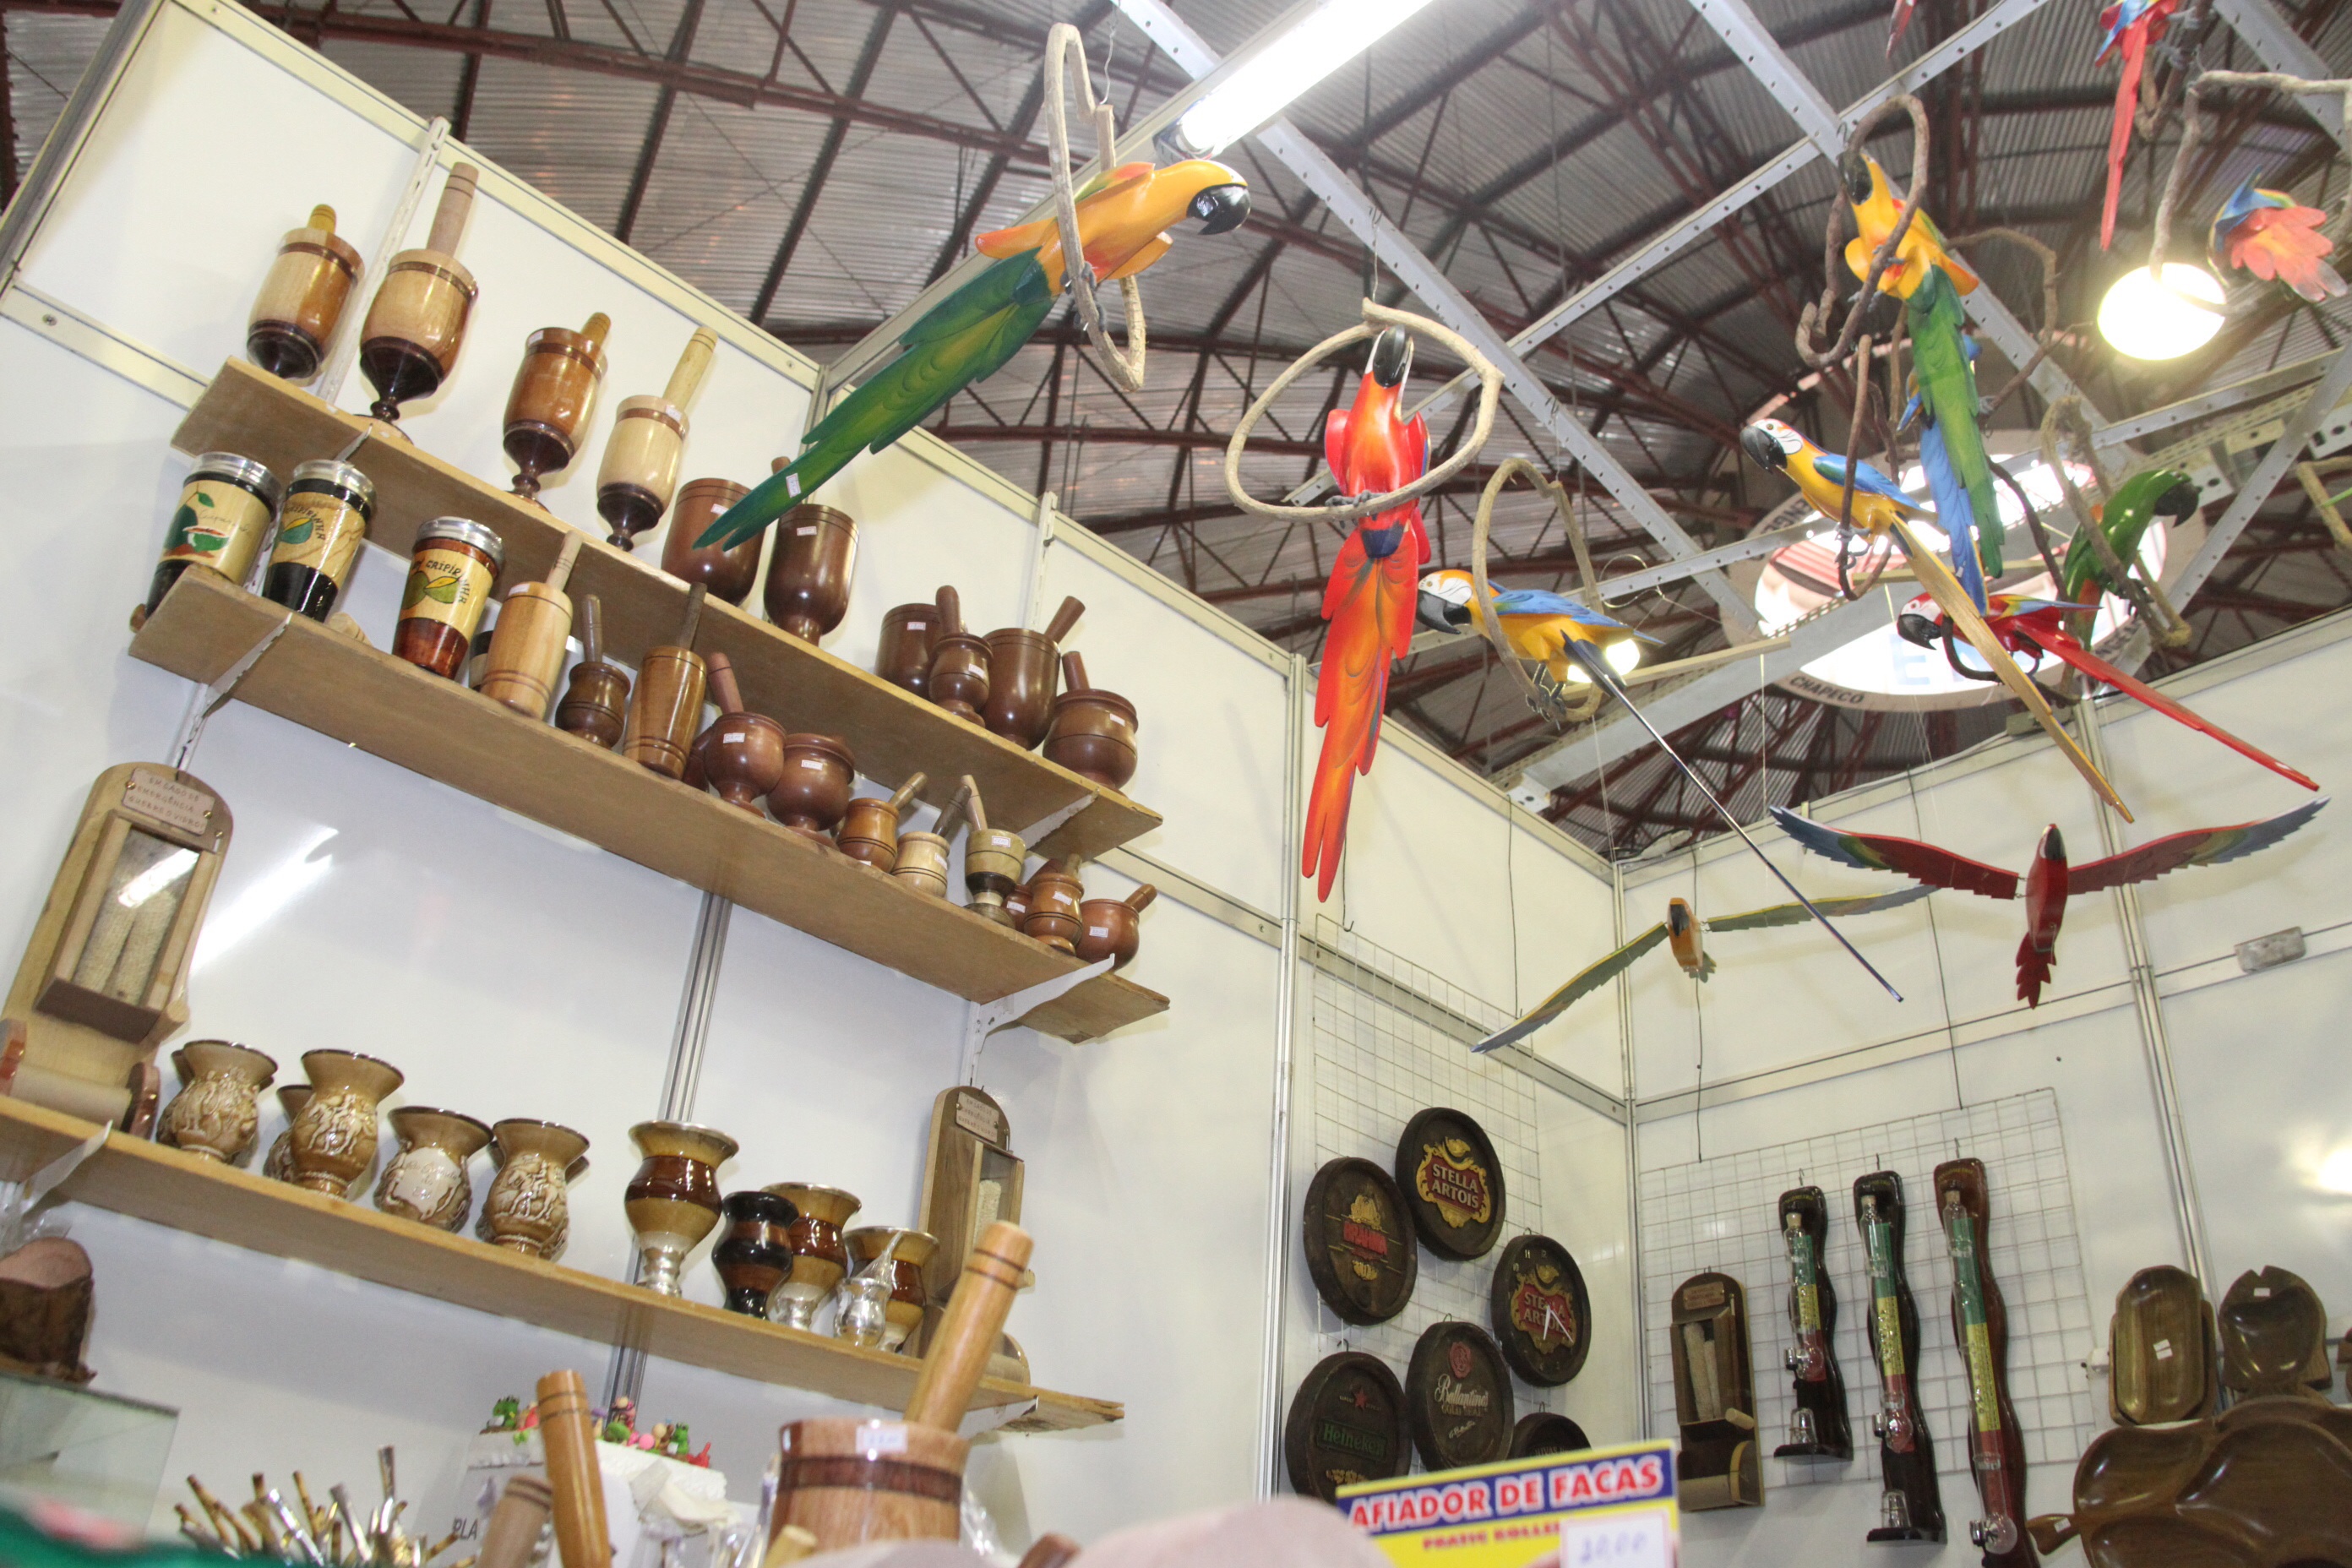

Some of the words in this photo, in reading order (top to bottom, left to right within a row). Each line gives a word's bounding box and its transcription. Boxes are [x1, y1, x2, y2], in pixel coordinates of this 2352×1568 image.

[1432, 1163, 1478, 1194] STELLA
[1432, 1179, 1479, 1209] ARTOIS
[1524, 1292, 1566, 1317] STEA
[1323, 1423, 1386, 1457] Heineken
[1352, 1487, 1485, 1527] AFIADOR
[1500, 1474, 1539, 1508] DE
[1554, 1458, 1660, 1500] FACAS
